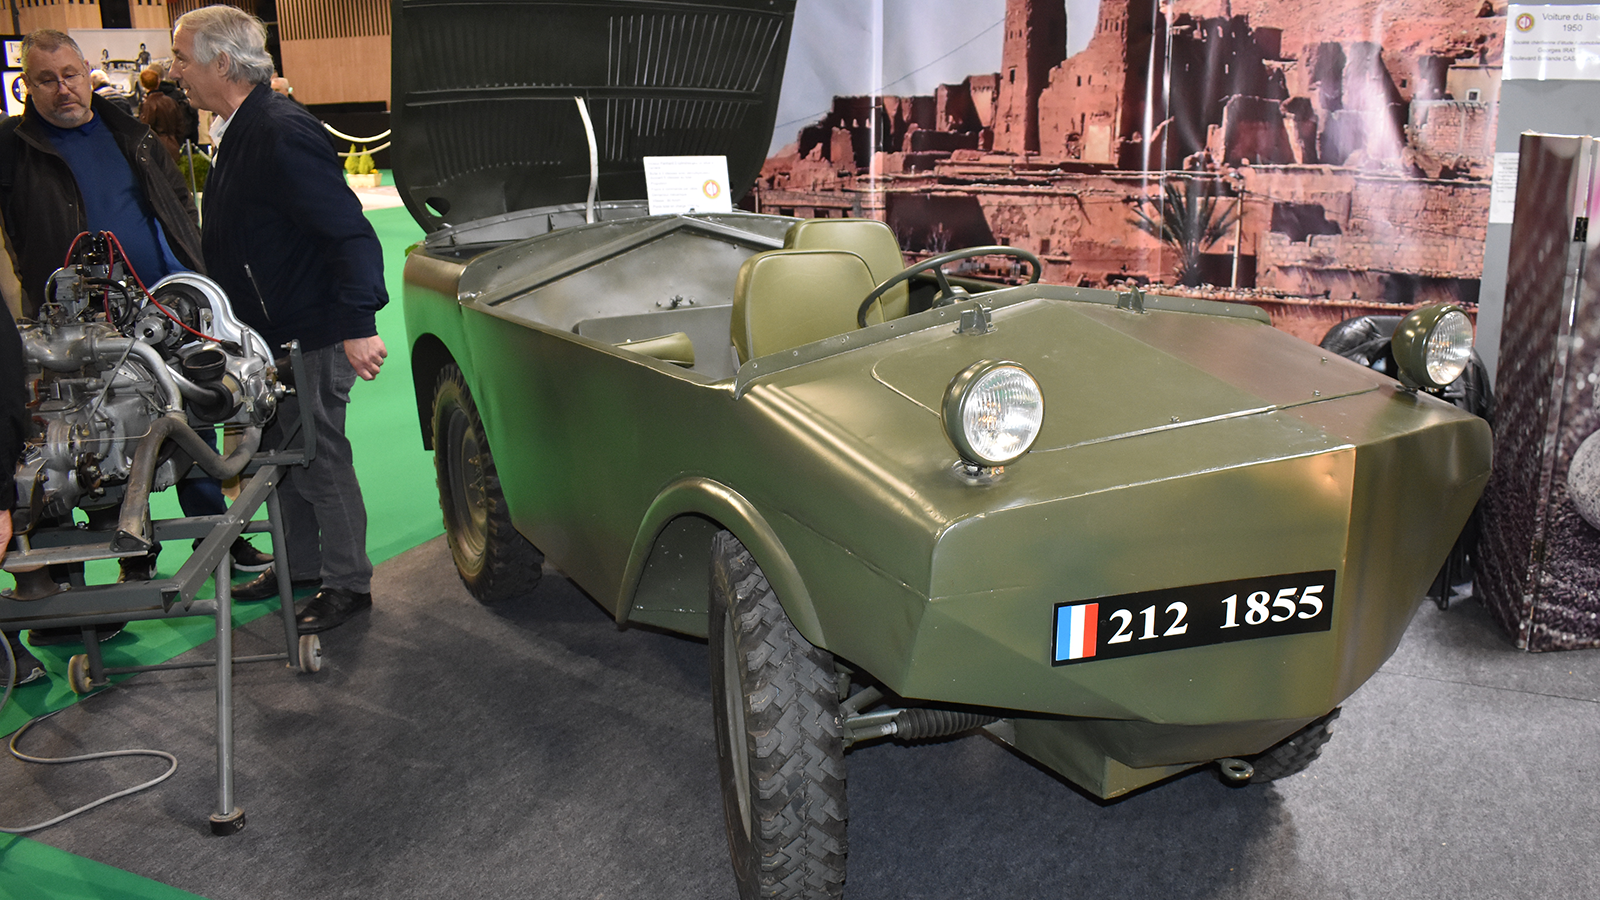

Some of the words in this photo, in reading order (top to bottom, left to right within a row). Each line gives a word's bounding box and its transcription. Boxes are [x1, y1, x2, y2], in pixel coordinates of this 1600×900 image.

[1542, 13, 1571, 21] Voiture
[1573, 13, 1584, 21] du
[1586, 13, 1600, 21] Ble
[1563, 24, 1583, 32] 1950
[1107, 601, 1189, 645] 212
[1219, 584, 1325, 629] 1855
